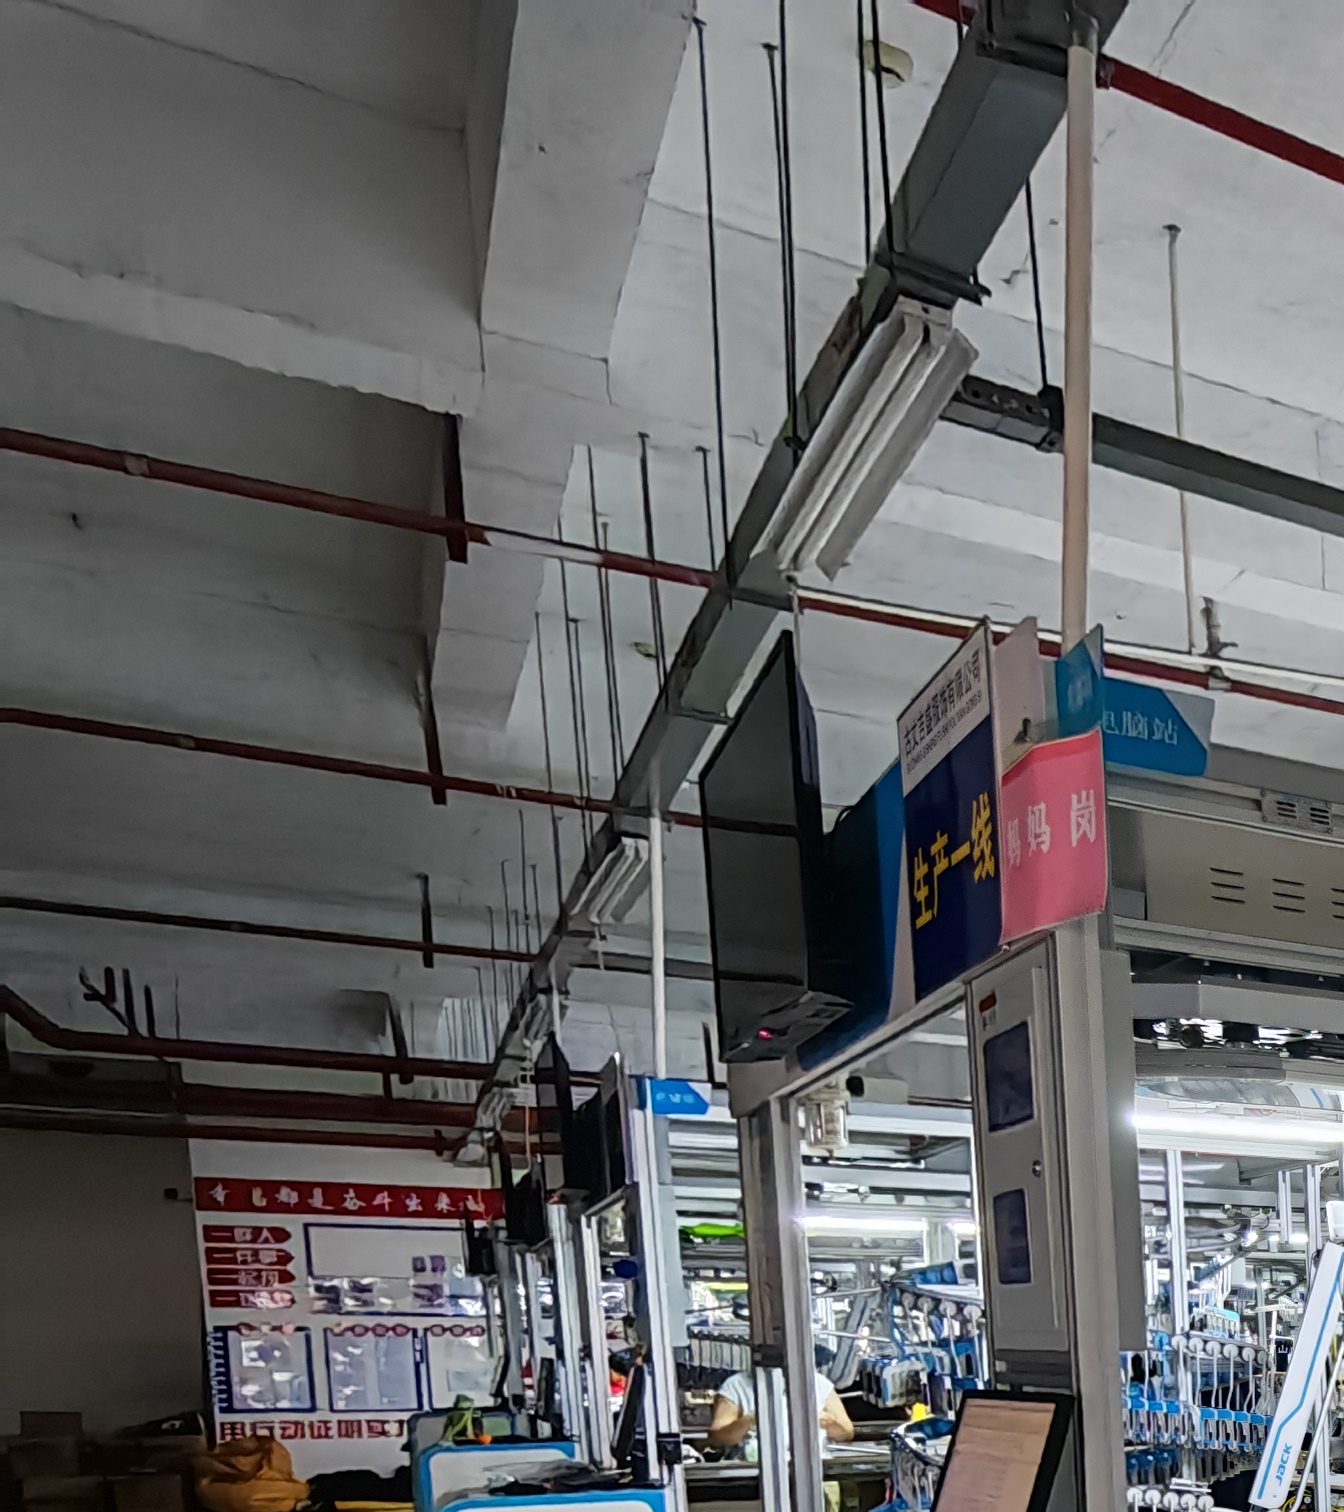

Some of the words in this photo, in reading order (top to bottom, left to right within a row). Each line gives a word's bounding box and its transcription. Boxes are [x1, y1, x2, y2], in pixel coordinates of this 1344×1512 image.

[913, 791, 995, 929] 生产一线
[1007, 789, 1097, 868] 妈妈岗
